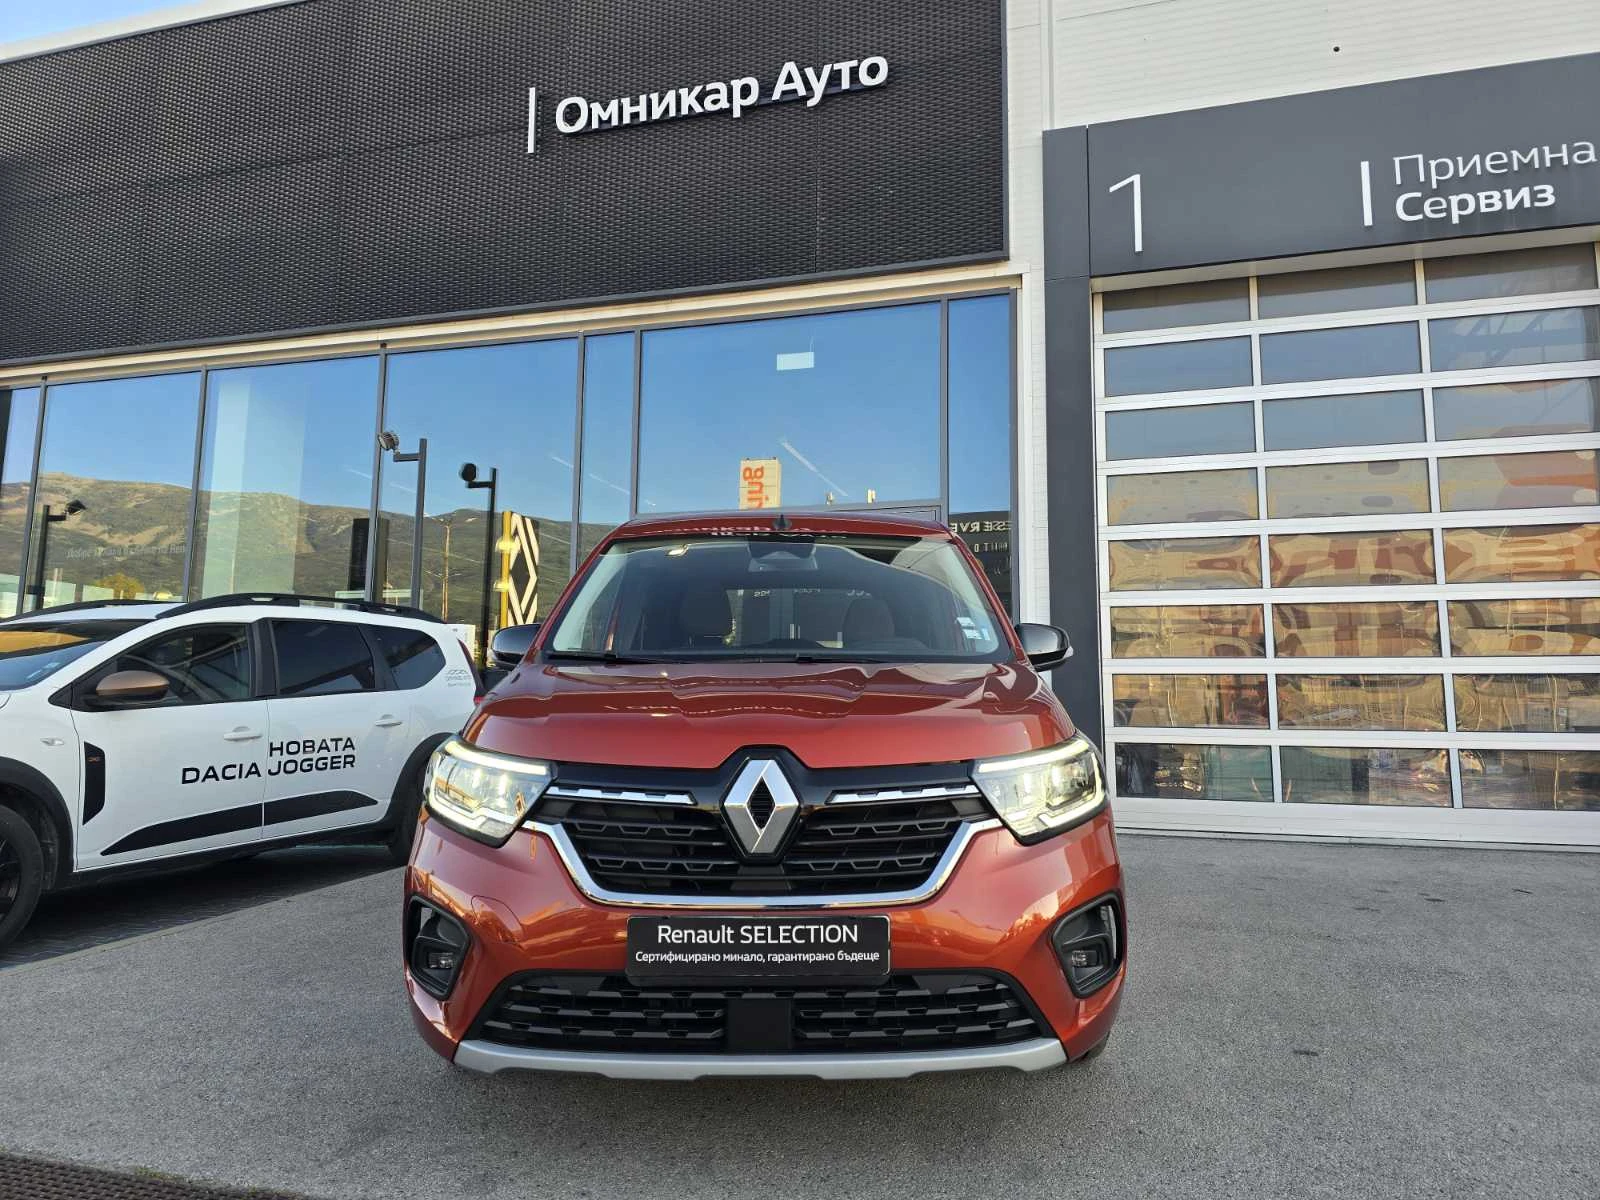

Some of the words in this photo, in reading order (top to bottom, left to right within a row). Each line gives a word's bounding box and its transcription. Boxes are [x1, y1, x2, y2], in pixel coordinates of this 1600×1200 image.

[555, 76, 760, 134] Омникар
[771, 56, 890, 108] Ауто
[1393, 140, 1597, 188] Приемна
[1109, 173, 1143, 252] 1
[1395, 183, 1556, 224] Сервиз
[181, 762, 261, 785] DACIA
[267, 754, 356, 776] JOGGER
[657, 925, 735, 944] Renault
[740, 925, 858, 944] SELECTION
[635, 951, 721, 965] Сертифицирано
[723, 952, 766, 963] минало,
[767, 951, 835, 964] гарантирано
[837, 950, 880, 962] бъдеще
